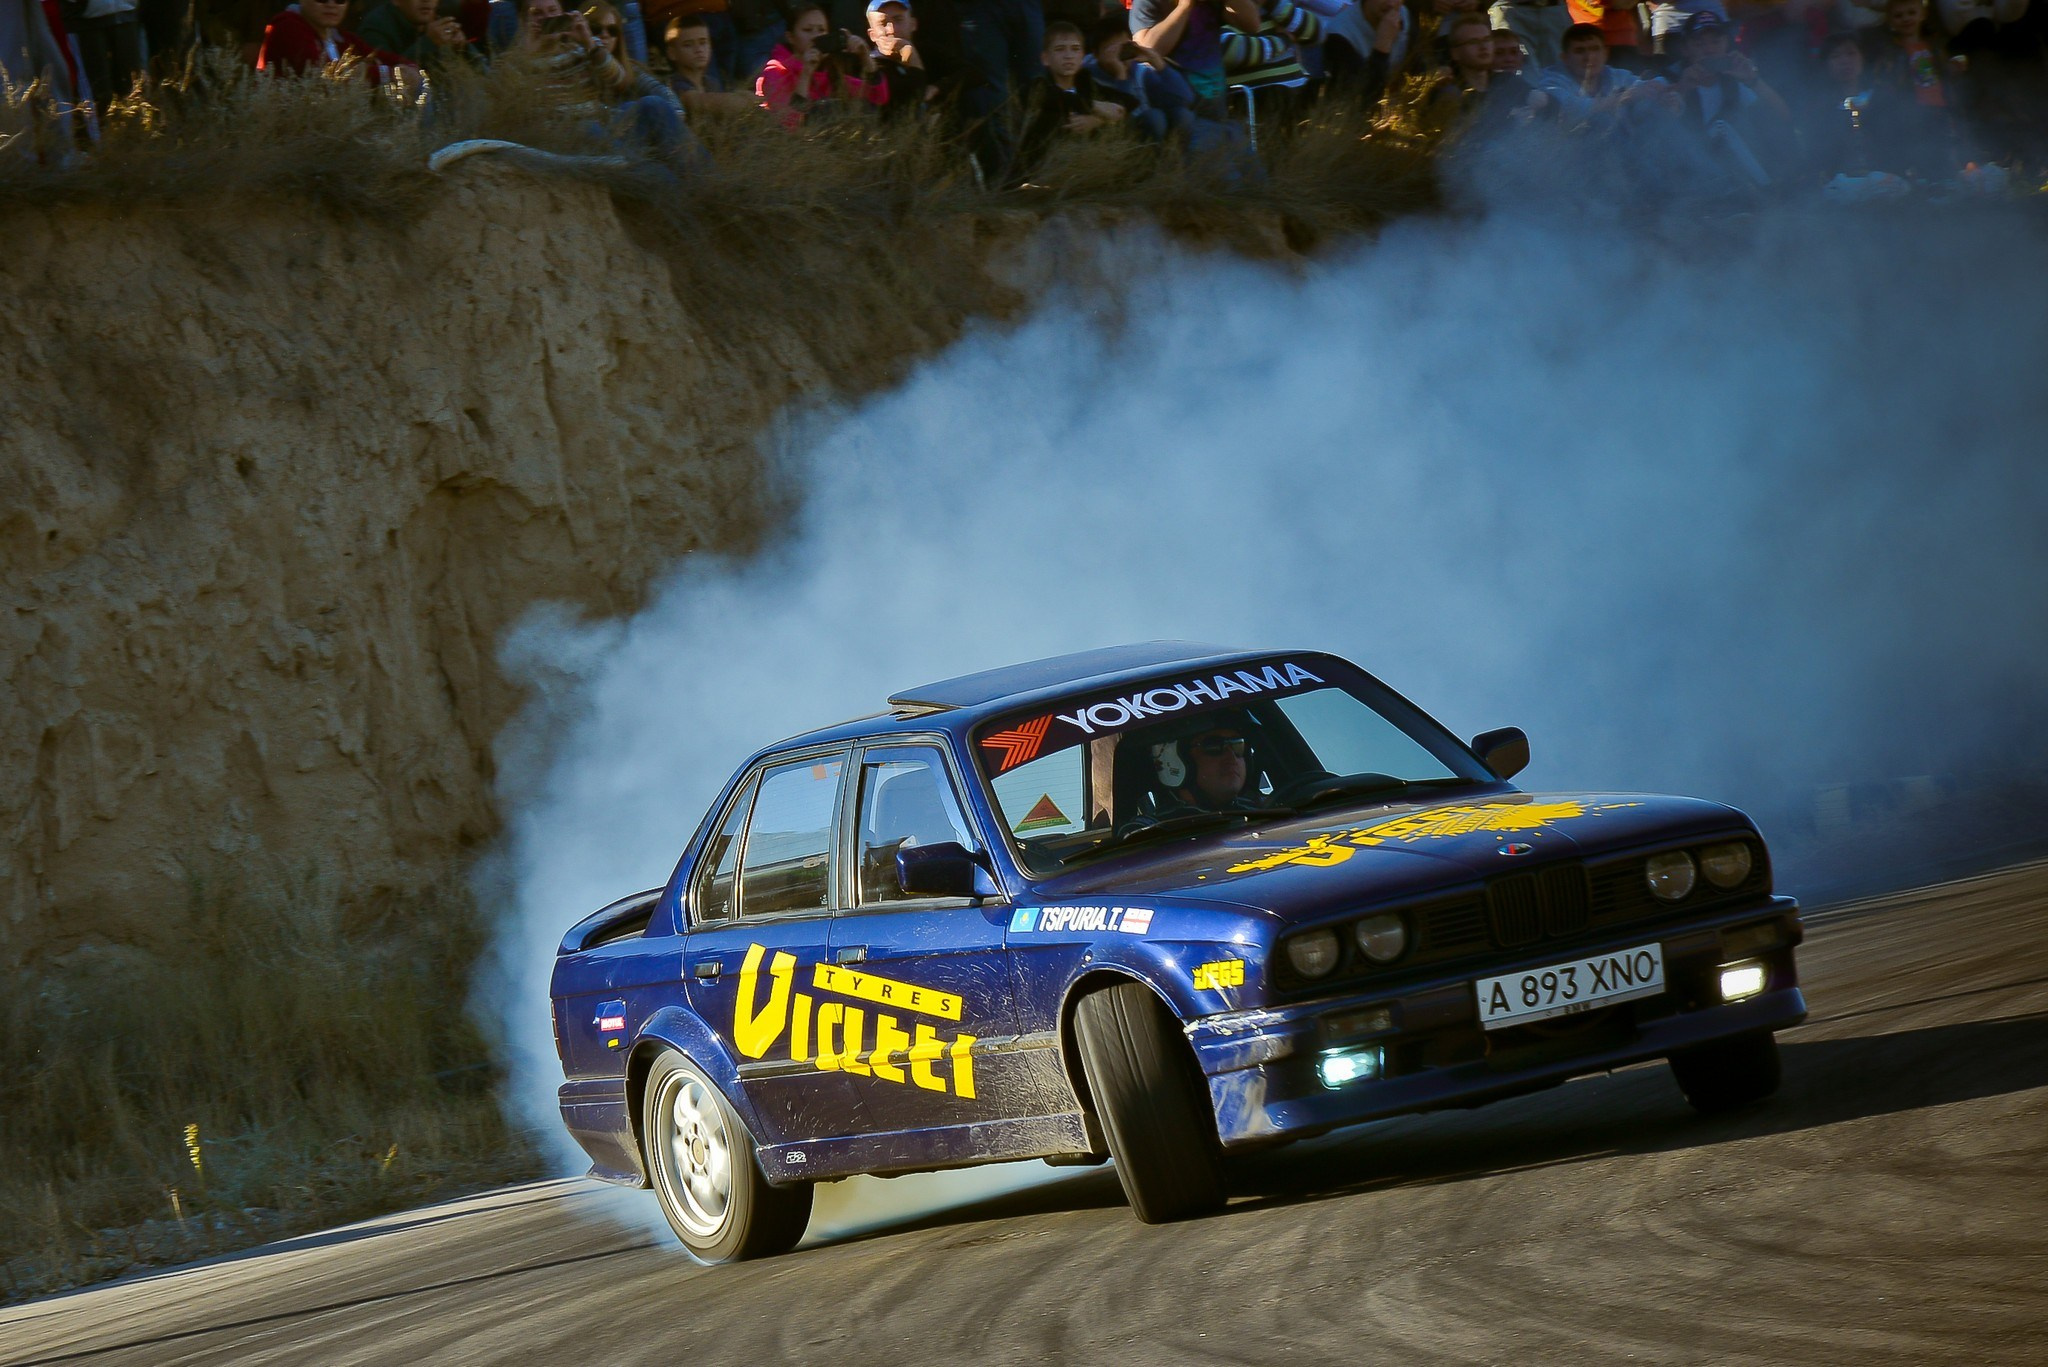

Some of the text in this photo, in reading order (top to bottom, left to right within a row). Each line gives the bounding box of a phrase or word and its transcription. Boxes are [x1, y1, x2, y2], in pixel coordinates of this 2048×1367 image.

[1056, 662, 1325, 734] YOKOHAMA
[825, 970, 951, 1012] TYRES
[1192, 959, 1244, 990] JEGS
[1489, 950, 1654, 1015] A 893 XNO
